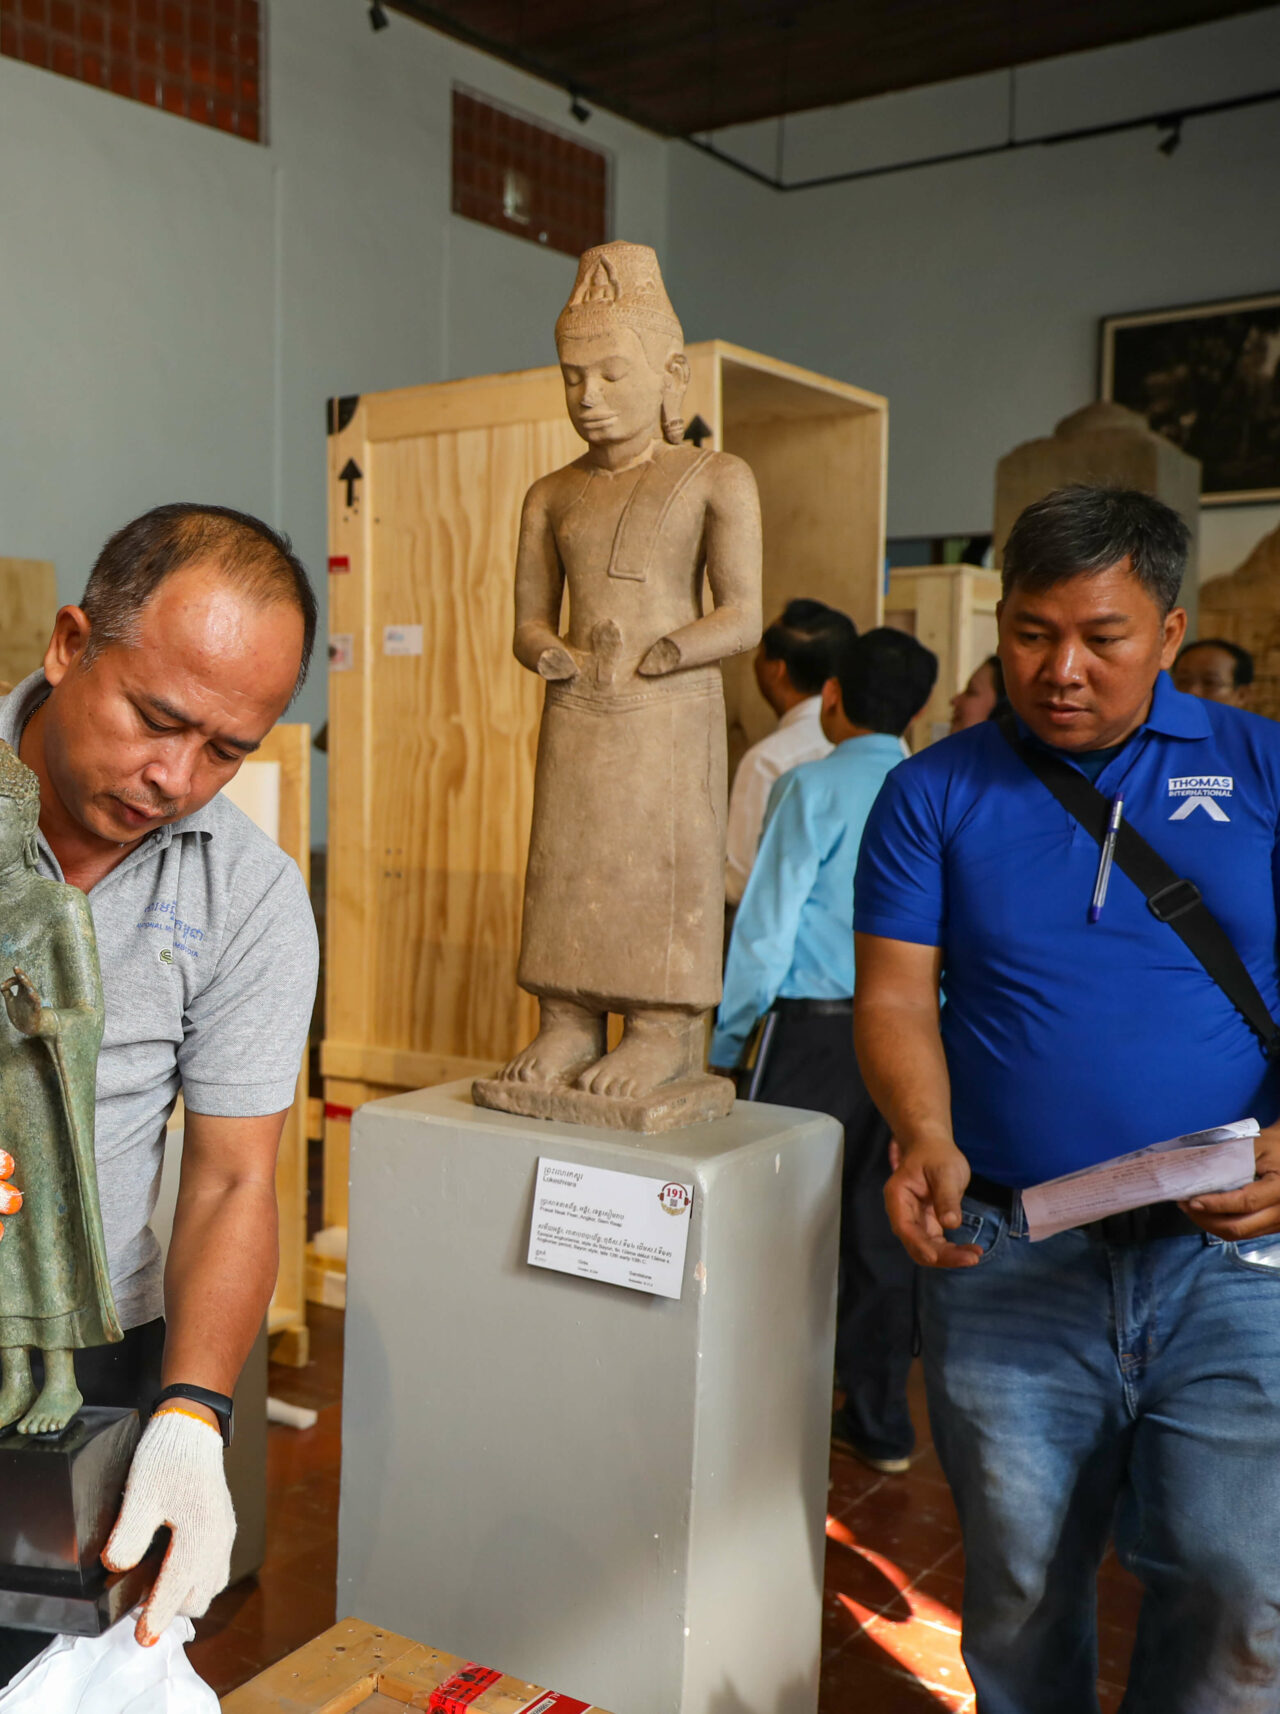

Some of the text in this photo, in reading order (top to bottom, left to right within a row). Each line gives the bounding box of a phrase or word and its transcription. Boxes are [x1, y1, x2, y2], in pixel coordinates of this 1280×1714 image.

[1171, 778, 1231, 788] THOMAS
[1169, 789, 1233, 797] INTERNATIONAL
[666, 1188, 683, 1199] 191
